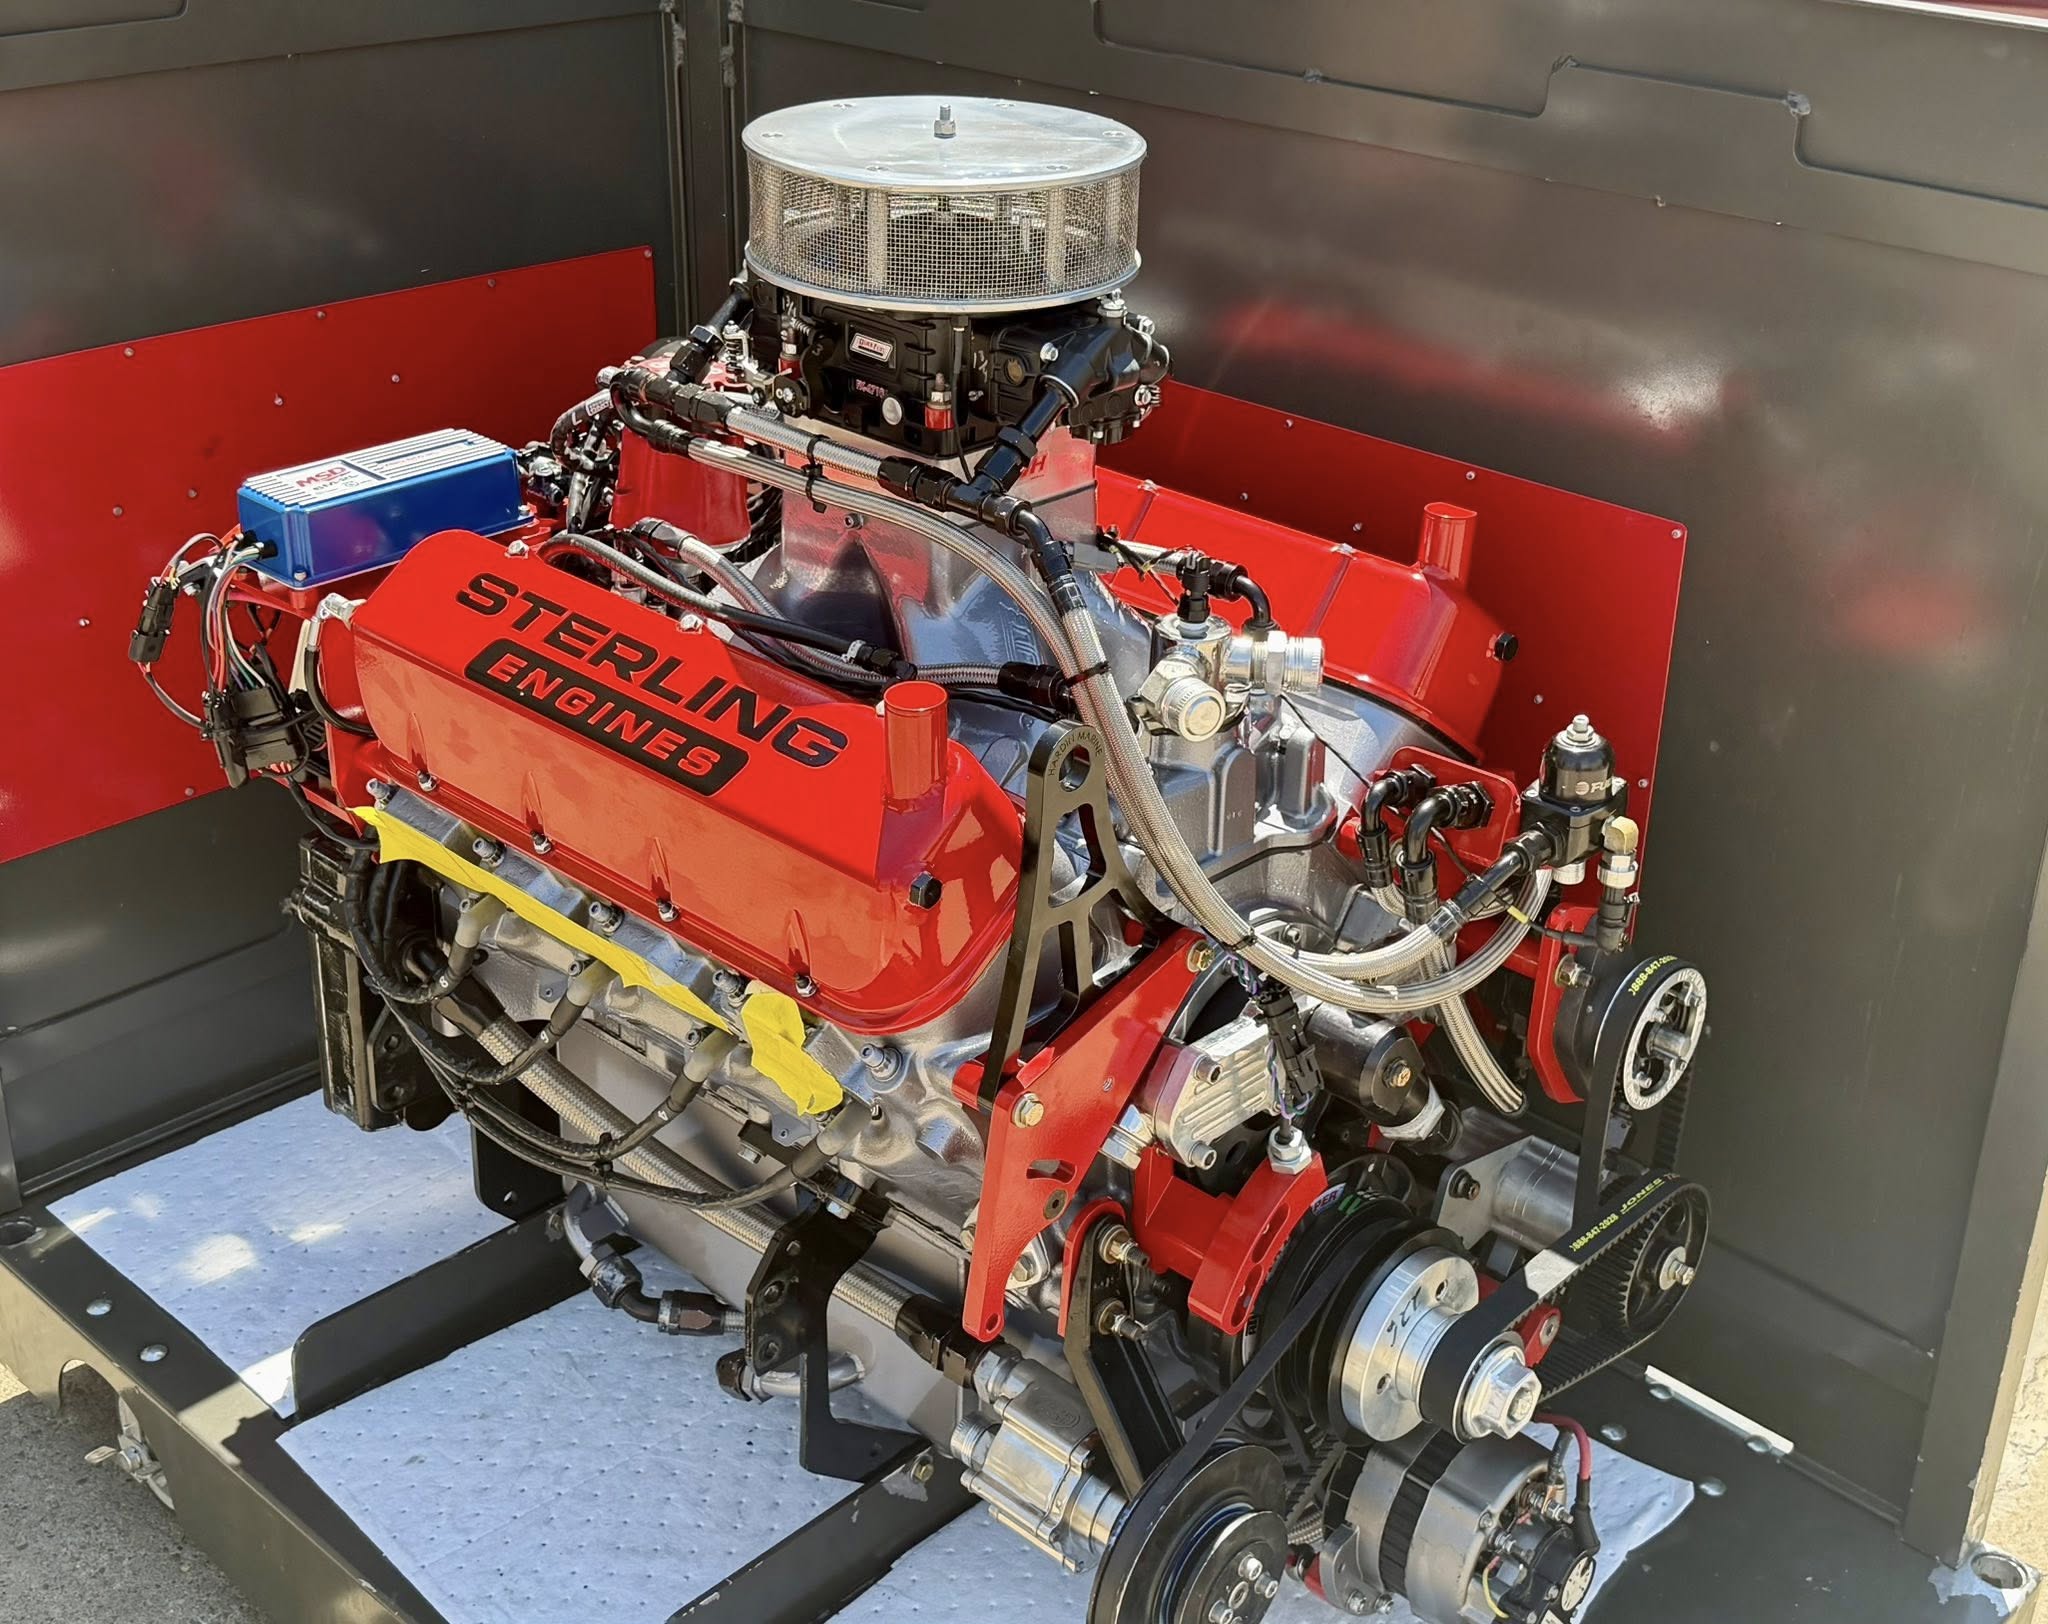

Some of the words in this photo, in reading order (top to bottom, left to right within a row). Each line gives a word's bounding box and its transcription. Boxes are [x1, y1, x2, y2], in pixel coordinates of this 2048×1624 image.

[295, 466, 348, 488] MSD
[455, 572, 850, 768] STERLING
[486, 653, 722, 777] ENGINES
[1077, 732, 1103, 757] MARINE
[1620, 1177, 1664, 1213] JONES
